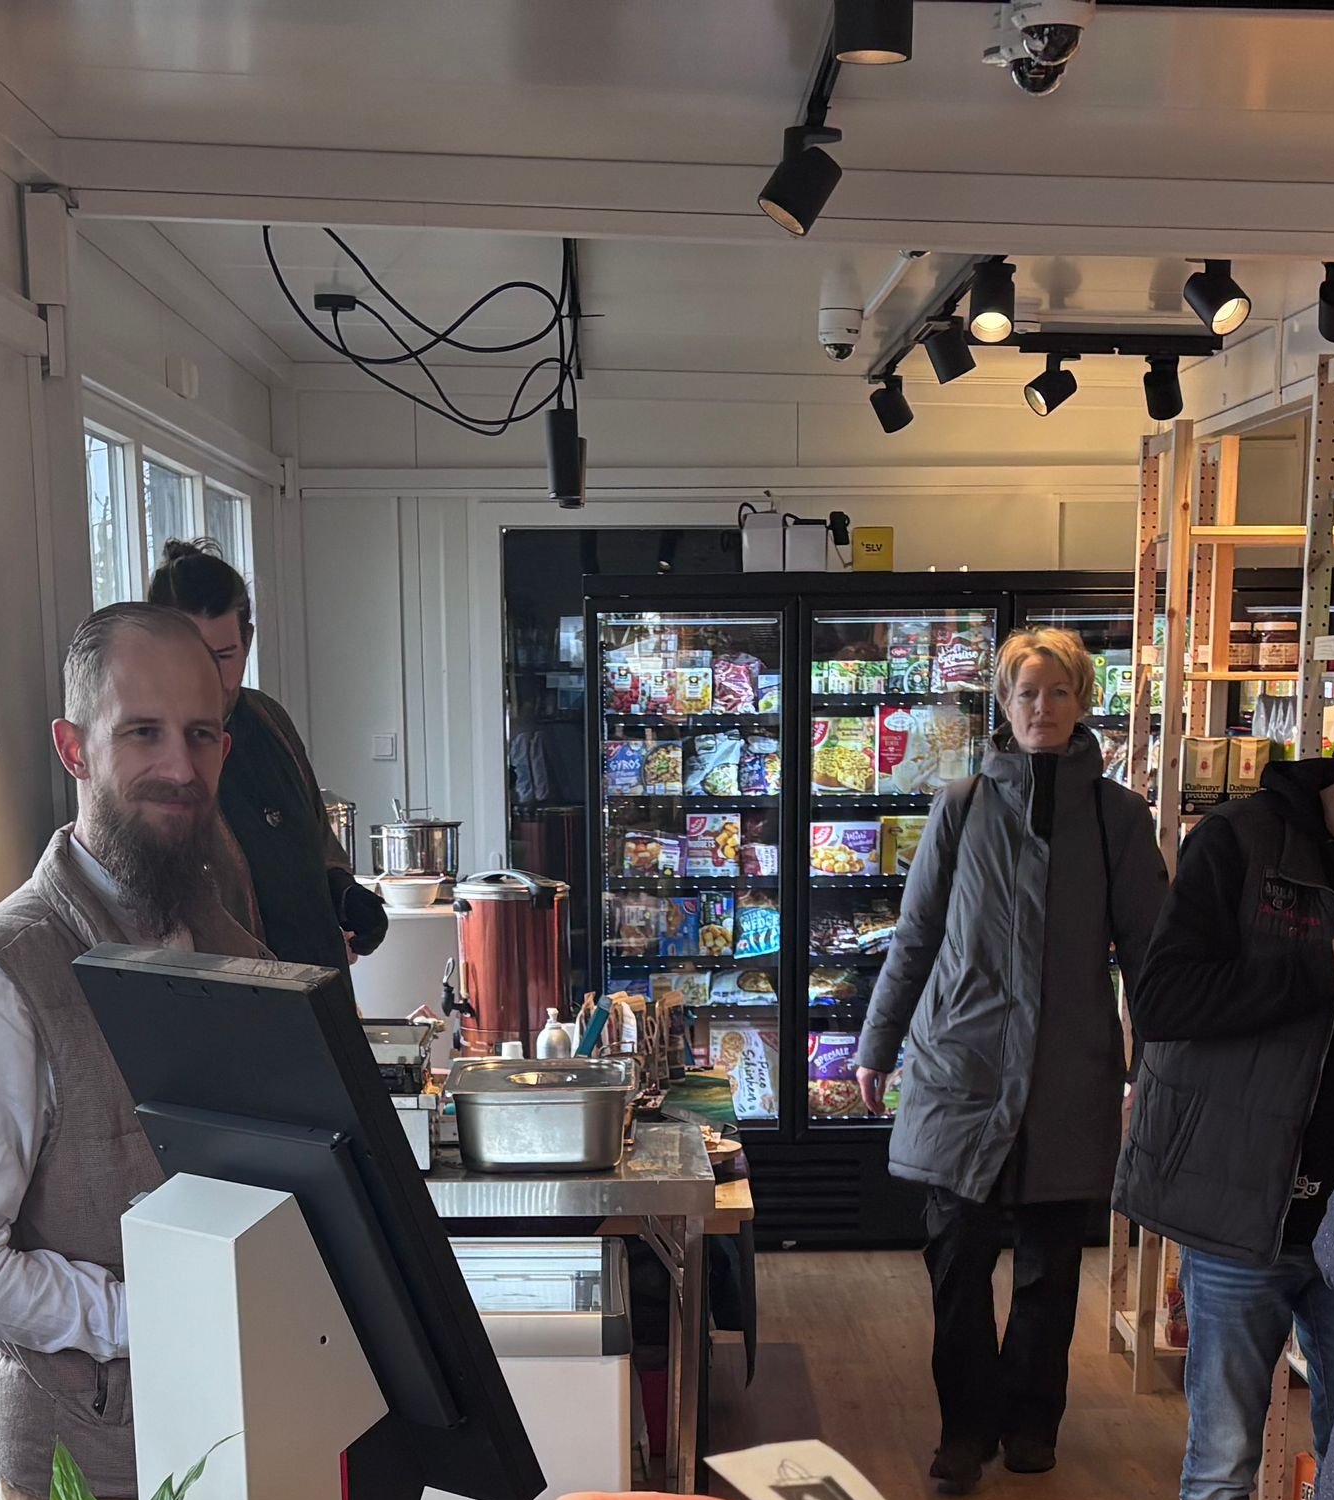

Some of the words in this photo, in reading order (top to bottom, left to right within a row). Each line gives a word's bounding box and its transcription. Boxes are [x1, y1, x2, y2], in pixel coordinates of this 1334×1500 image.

[865, 543, 883, 552] SLV
[609, 757, 641, 771] GYROS
[814, 1047, 850, 1067] SPECIALE
